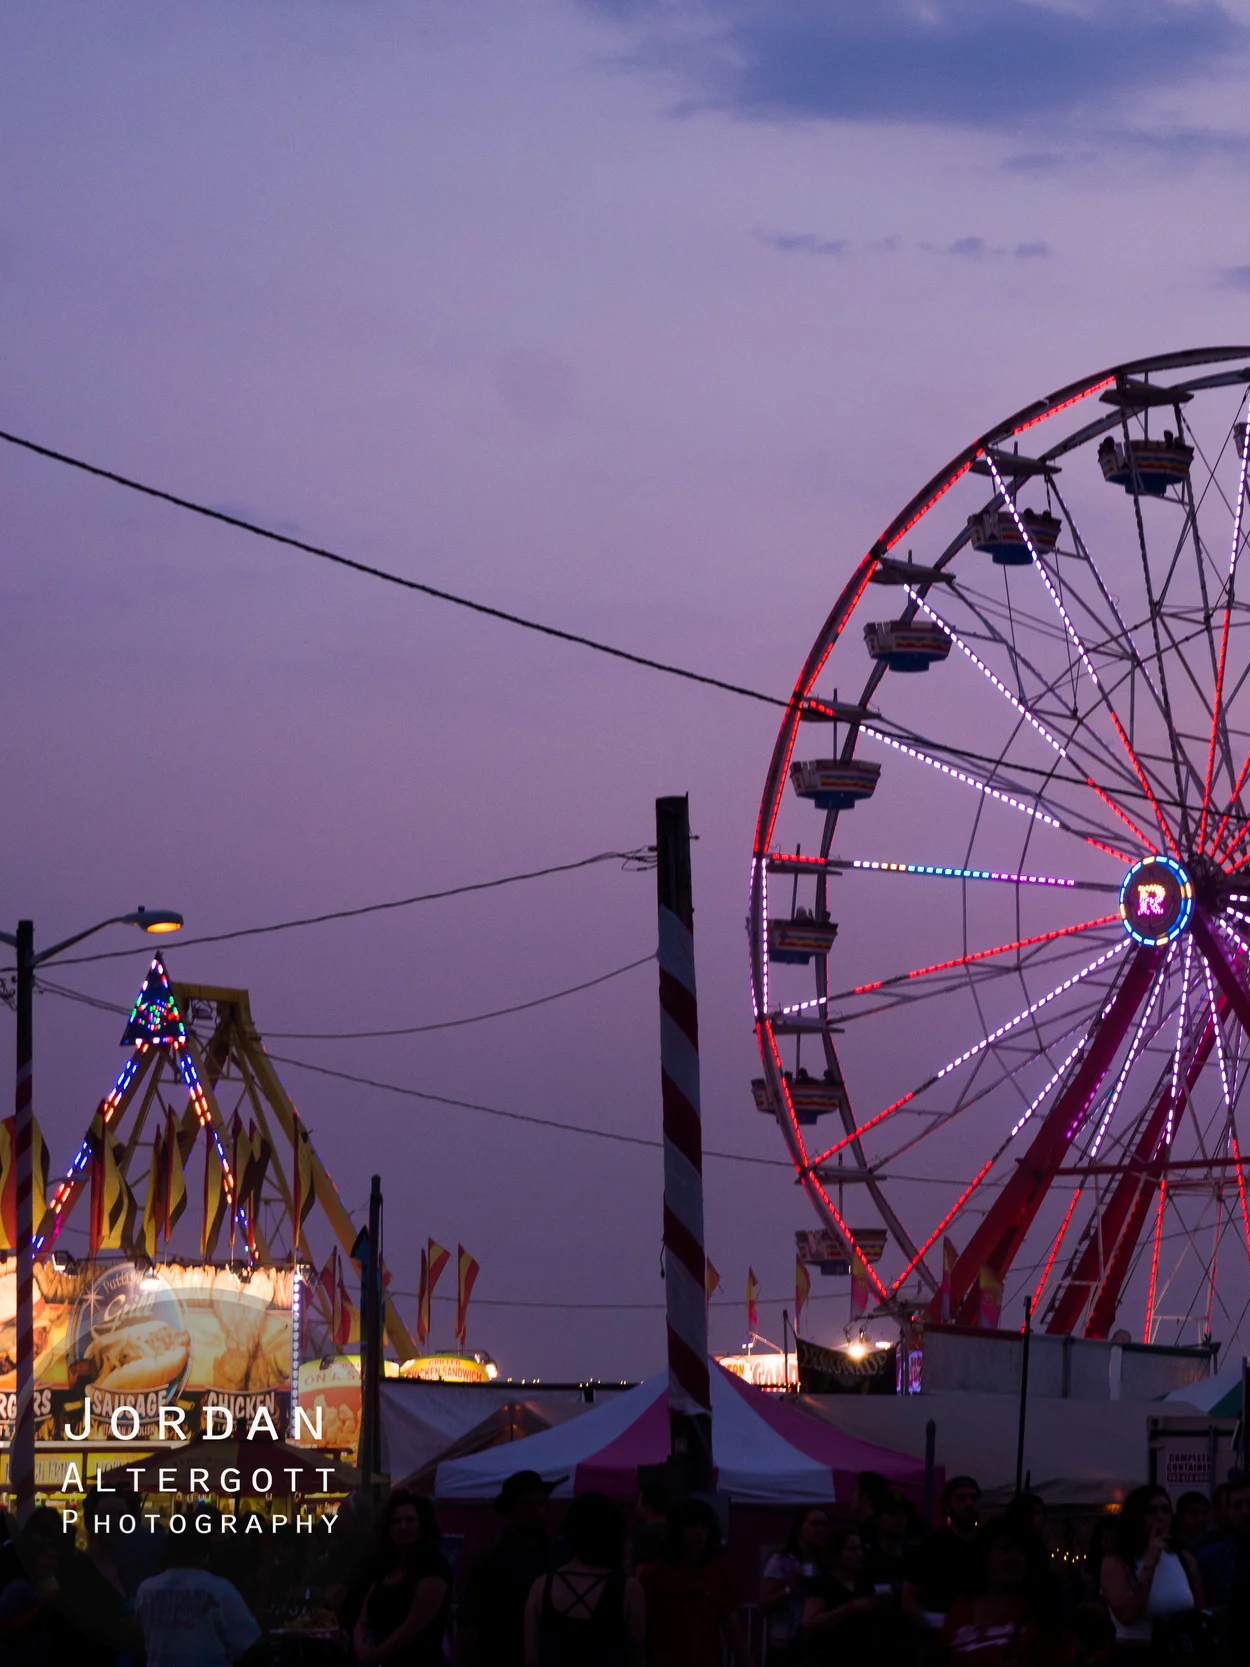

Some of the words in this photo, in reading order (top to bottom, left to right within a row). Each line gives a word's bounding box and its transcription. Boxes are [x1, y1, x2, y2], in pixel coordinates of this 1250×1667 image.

[1137, 883, 1166, 917] R
[442, 1367, 482, 1382] SANDWICH
[92, 1389, 168, 1420] SAUSAGE
[207, 1390, 275, 1420] CHICKEN
